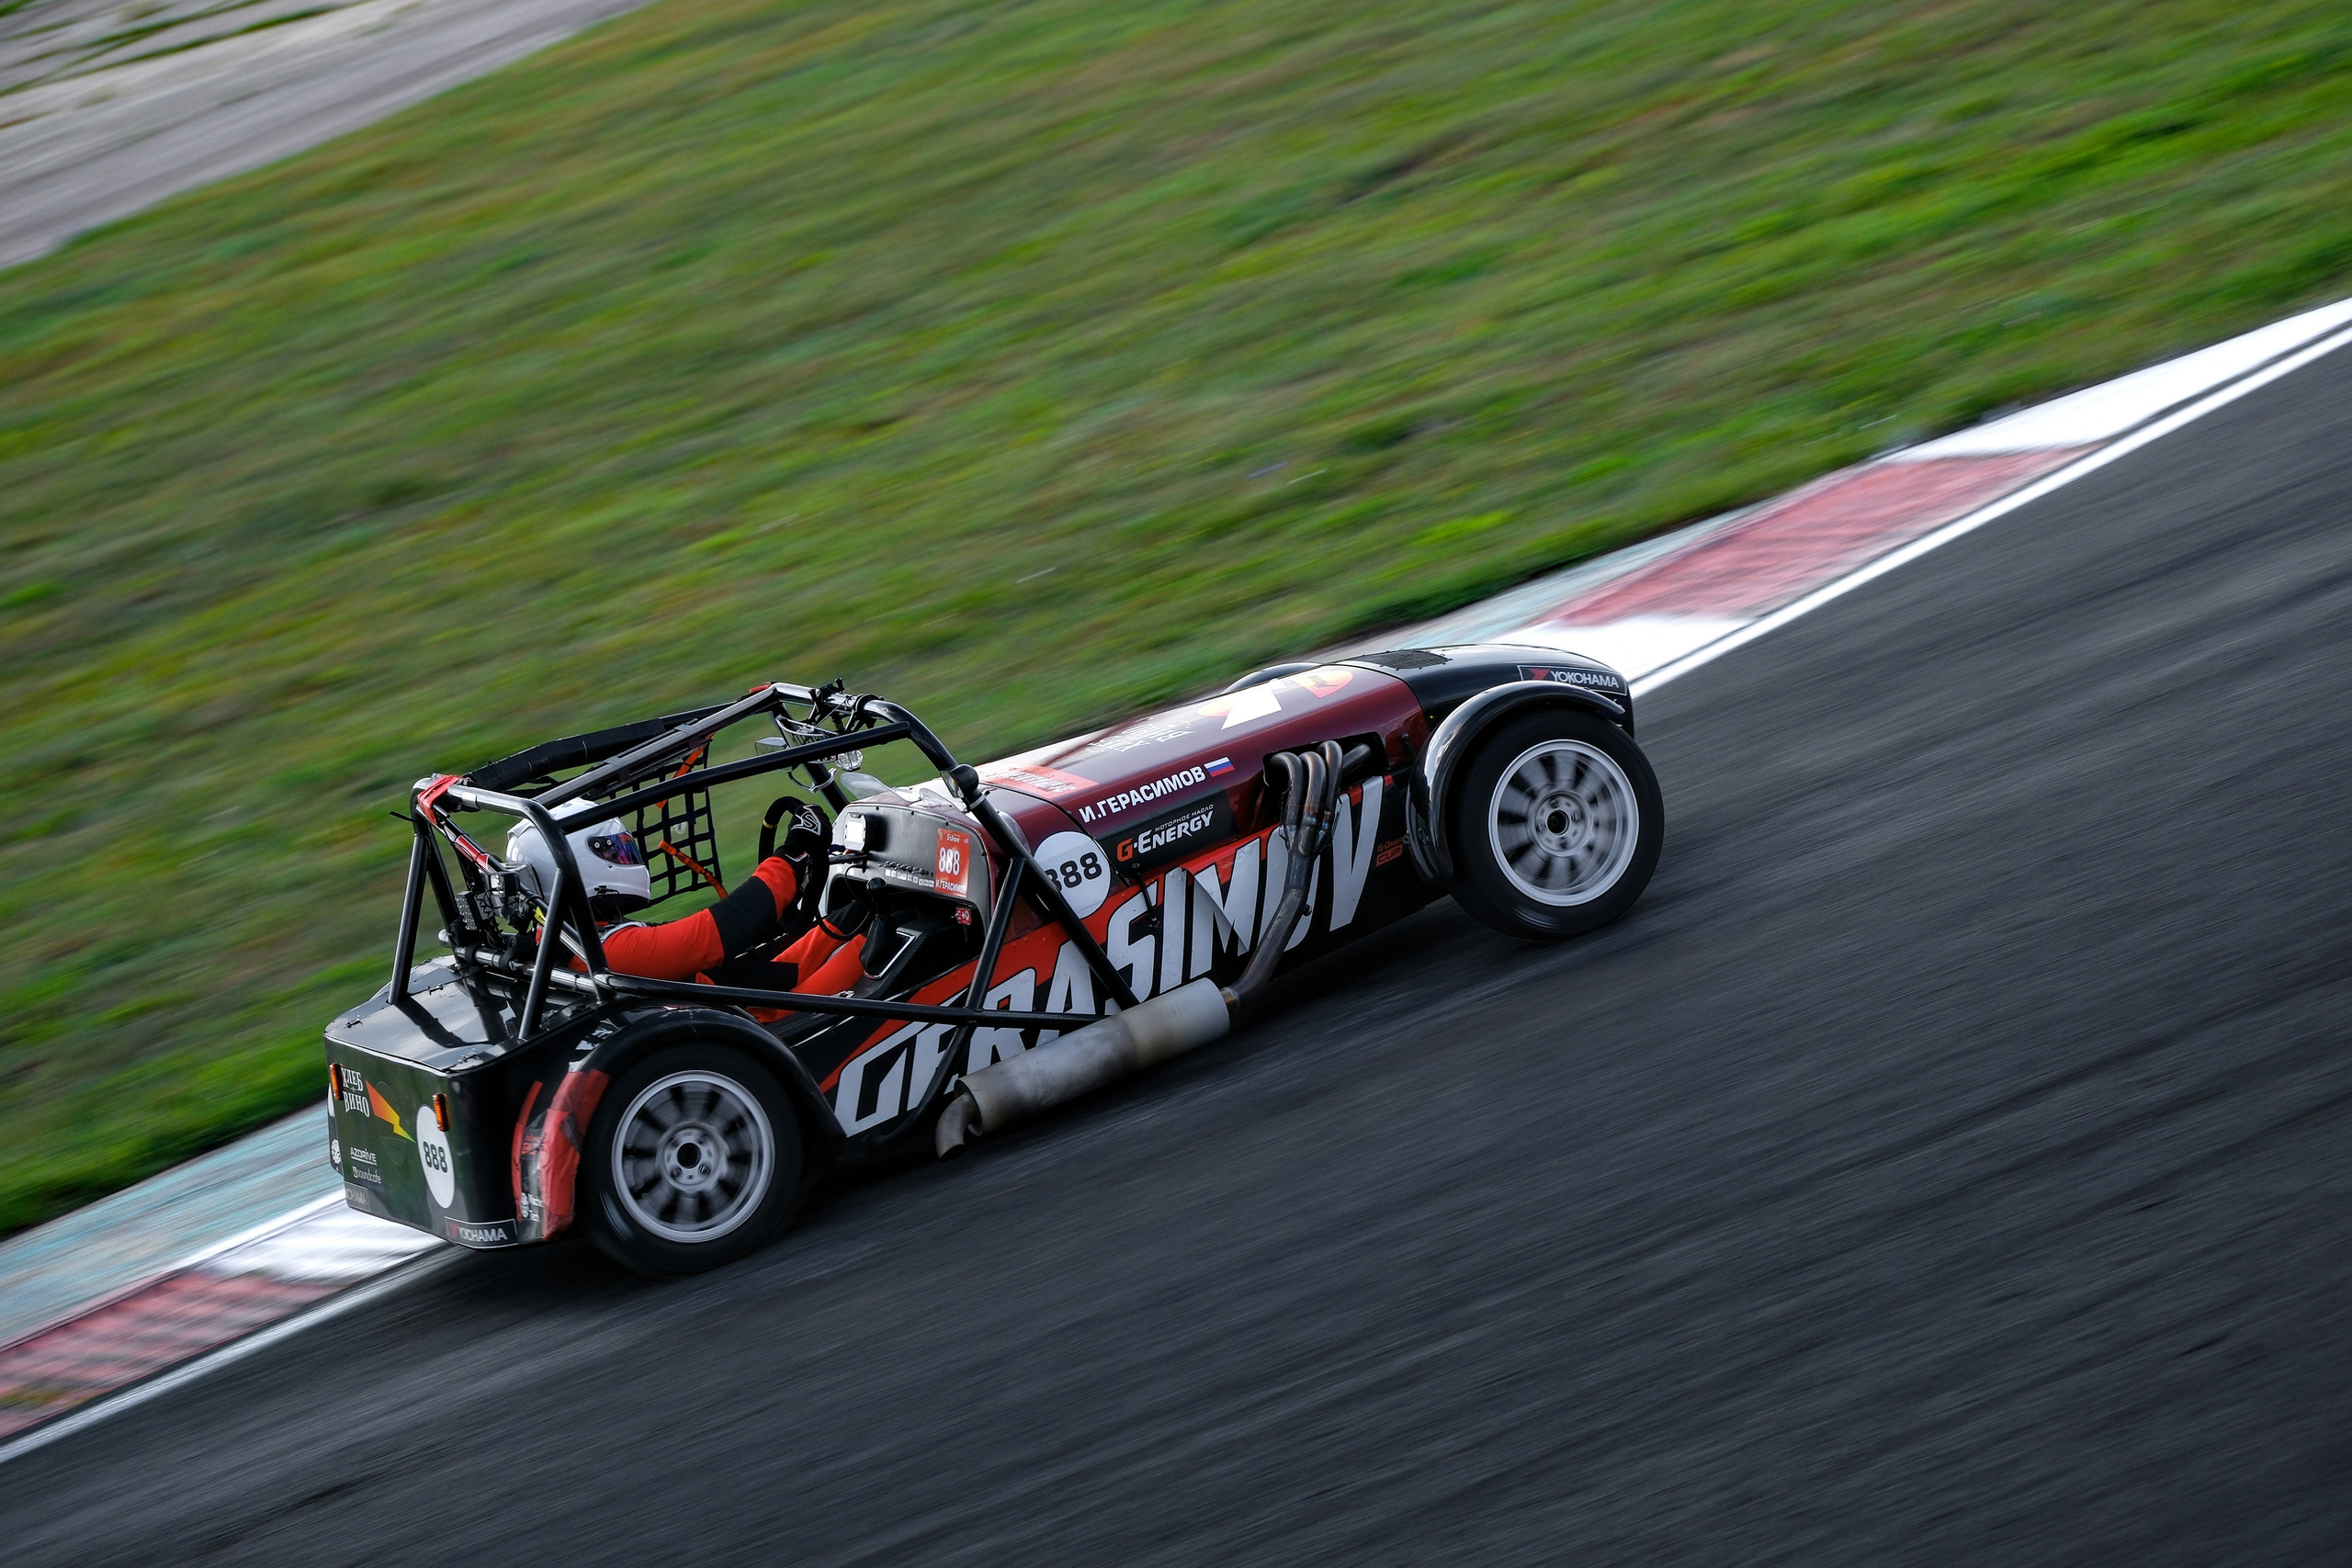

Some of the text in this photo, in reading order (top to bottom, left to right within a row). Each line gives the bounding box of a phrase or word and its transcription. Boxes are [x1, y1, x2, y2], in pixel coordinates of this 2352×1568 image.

[1550, 671, 1619, 688] YOKOHAMA
[1079, 766, 1206, 824] И.ГЕРАСИМОВ
[939, 847, 960, 875] 888
[1378, 846, 1401, 863] CUP
[340, 1066, 364, 1092] ХЛЕБ
[342, 1090, 370, 1118] ВИНО
[423, 1141, 447, 1173] 888
